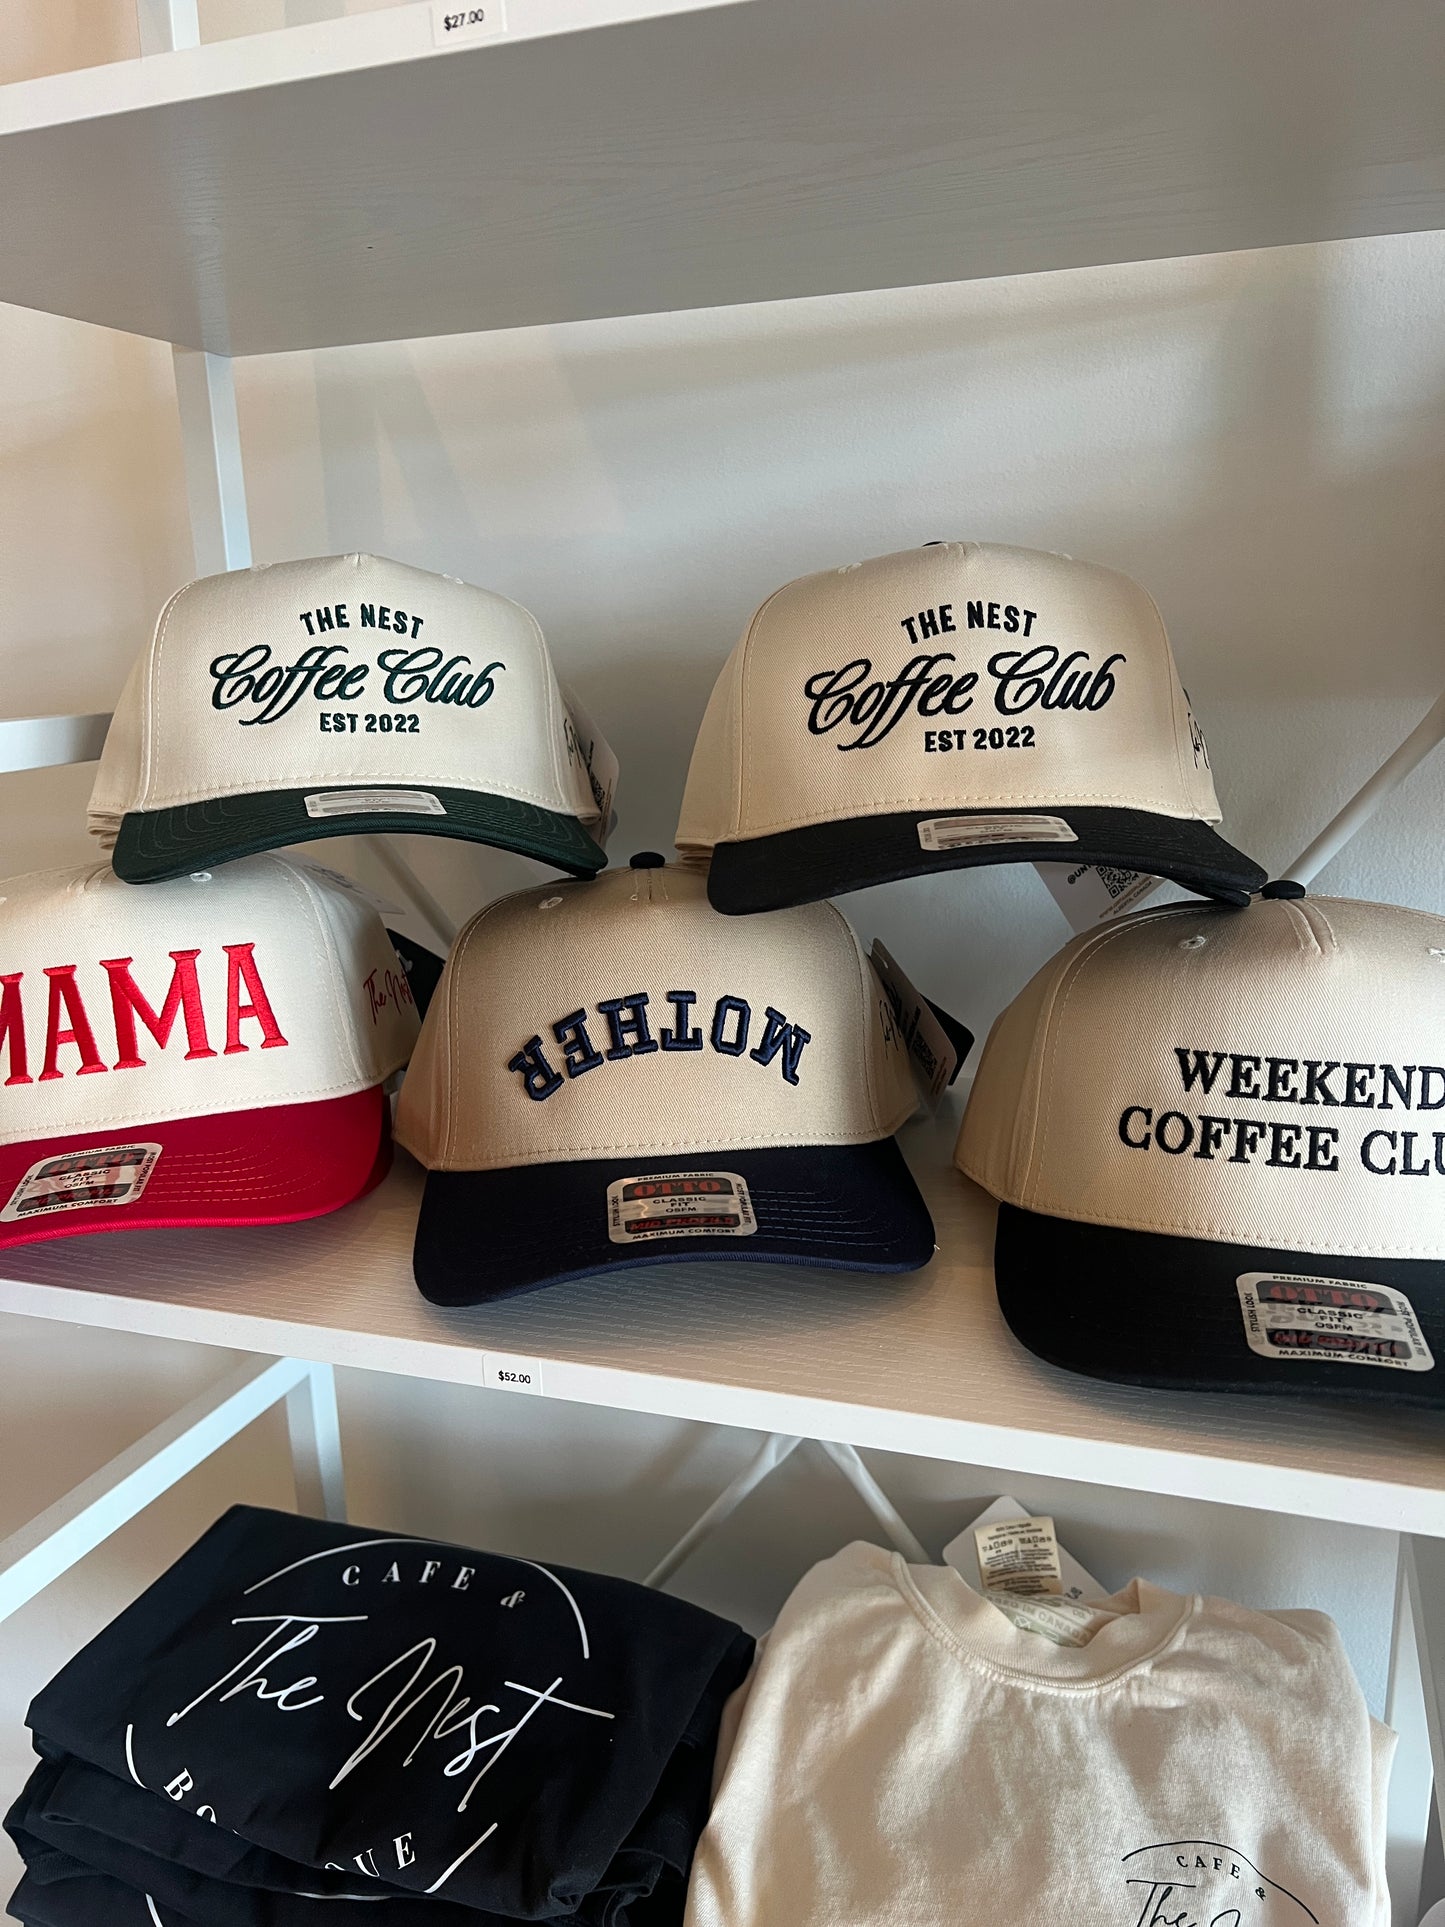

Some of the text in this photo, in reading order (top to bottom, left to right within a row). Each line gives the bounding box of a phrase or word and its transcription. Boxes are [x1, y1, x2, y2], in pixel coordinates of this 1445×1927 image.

[444, 8, 484, 31] $27.00
[300, 603, 425, 639] THE NEST
[901, 600, 1038, 645] THE NEST
[209, 644, 507, 726] Coffee Club
[804, 645, 1127, 752] Coffee Club
[319, 712, 420, 734] EST 2022
[924, 725, 1036, 753] EST 2022
[0, 942, 289, 1086] AMA
[508, 990, 811, 1102] MOTHER
[1174, 1047, 1445, 1111] WEEKEND
[1118, 1105, 1340, 1172] COFFEE
[58, 1169, 111, 1181] CLASSIC
[637, 1173, 681, 1182] PREMIUM
[633, 1180, 721, 1197] OTTO
[17, 1199, 118, 1218] MAXIMUM COMFORT
[653, 1197, 707, 1205] CLASSIC
[633, 1229, 685, 1240] MAXIMUM
[1272, 1275, 1368, 1289] PREMIUM FABRIC
[1297, 1307, 1364, 1320] CLASSIC
[1315, 1322, 1353, 1332] OSFM
[1278, 1349, 1408, 1367] MAXIMUM COMFORT
[498, 1370, 531, 1384] $52.00
[342, 1559, 526, 1608] CAFE &
[166, 1615, 614, 1813] The Nest
[1176, 1855, 1241, 1879] CAFE
